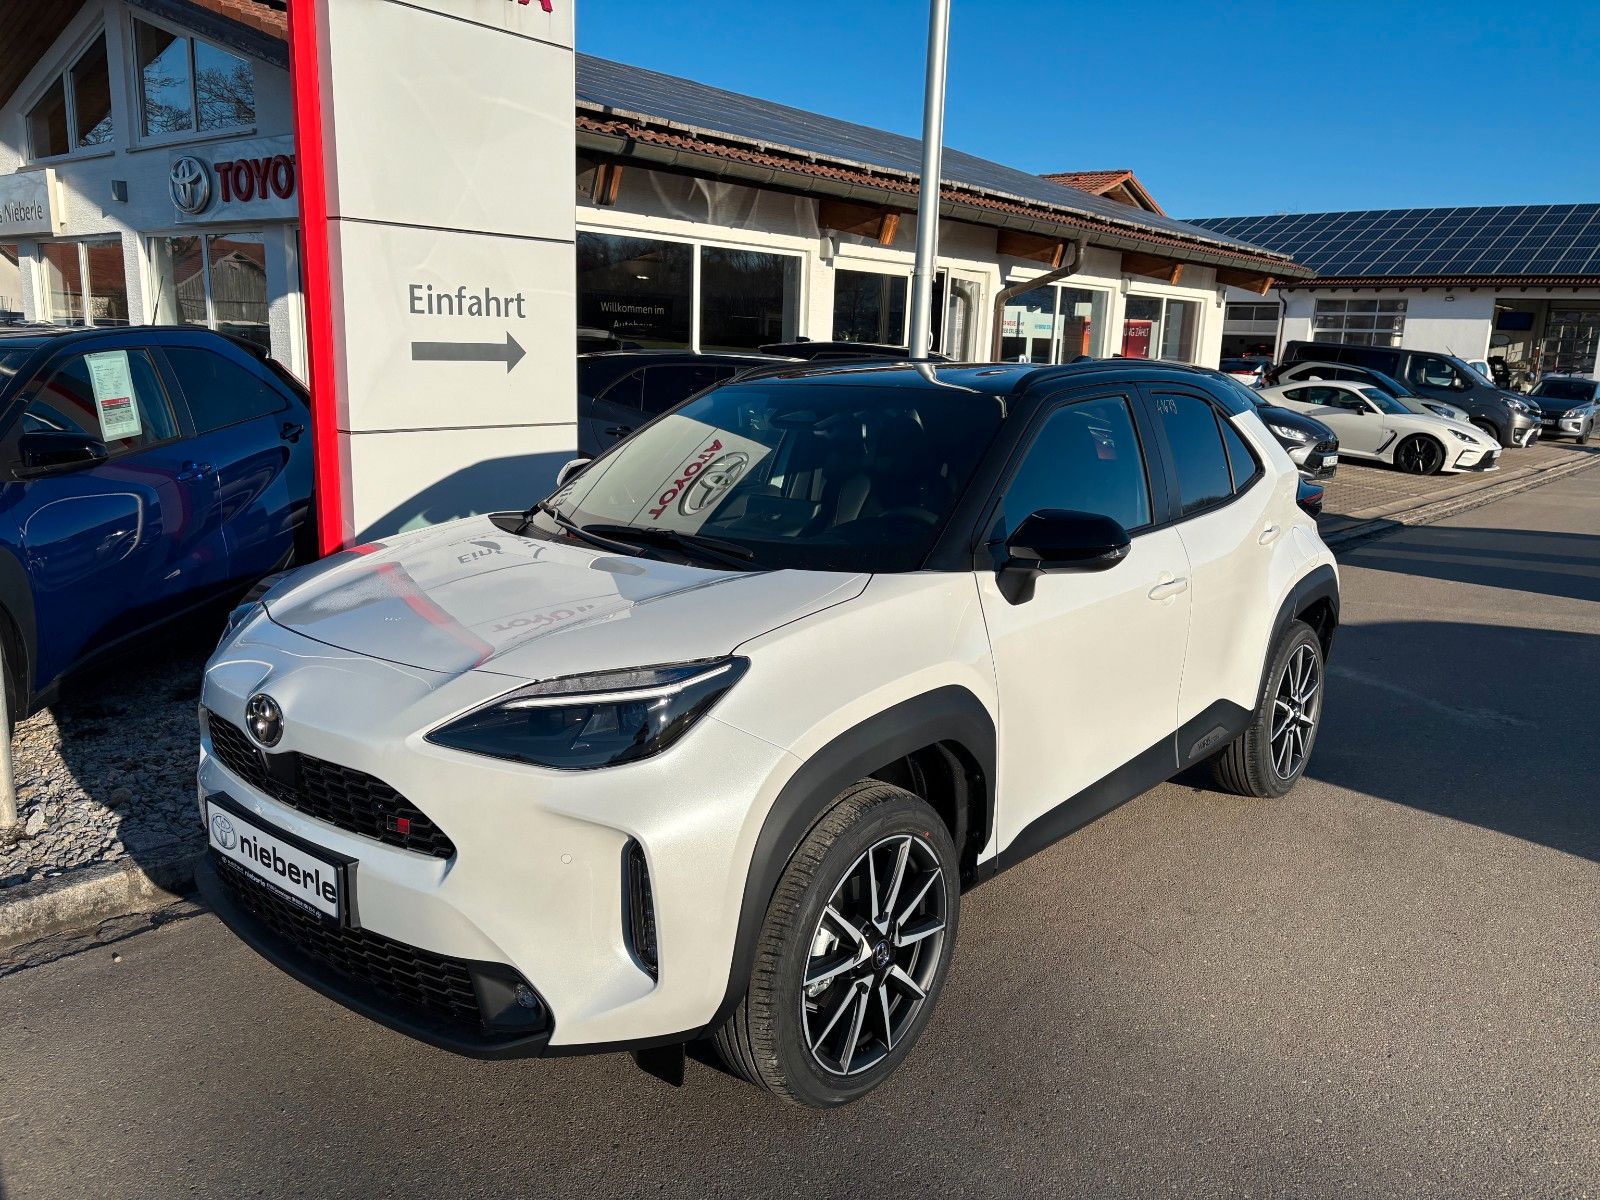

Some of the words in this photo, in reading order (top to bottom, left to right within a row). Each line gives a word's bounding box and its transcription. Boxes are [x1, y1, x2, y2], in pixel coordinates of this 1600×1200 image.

[214, 154, 296, 203] TOYO
[4, 199, 44, 224] Nieberle
[409, 284, 526, 318] Einfahrt
[600, 301, 653, 315] Willkommen
[654, 305, 665, 315] im
[240, 835, 337, 904] nieberle
